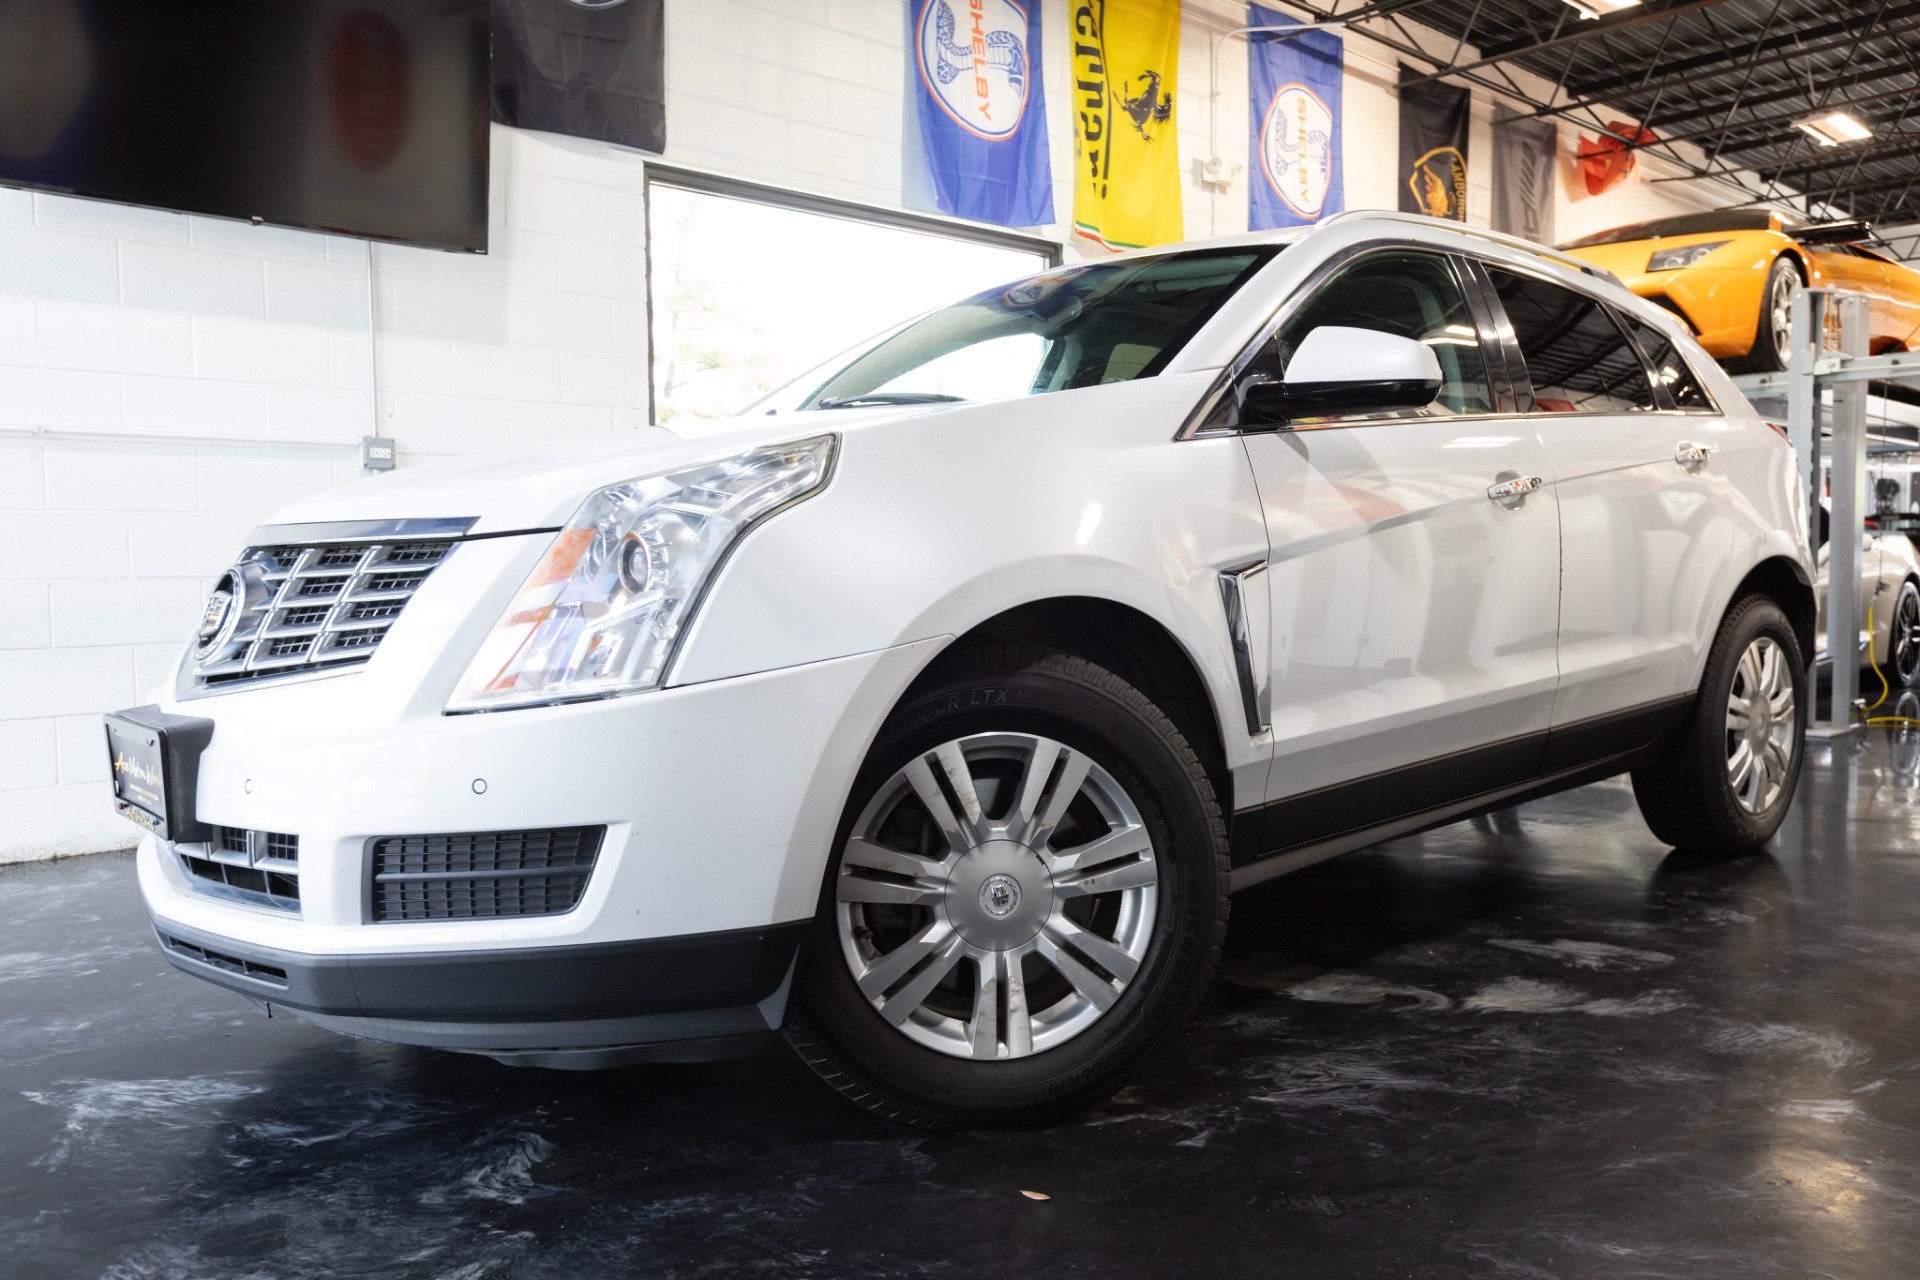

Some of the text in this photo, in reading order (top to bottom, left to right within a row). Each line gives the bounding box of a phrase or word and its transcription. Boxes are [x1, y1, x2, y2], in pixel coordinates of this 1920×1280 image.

[970, 0, 992, 122] SHELBY
[1295, 97, 1308, 204] SHELBY
[970, 688, 1010, 706] LTX
